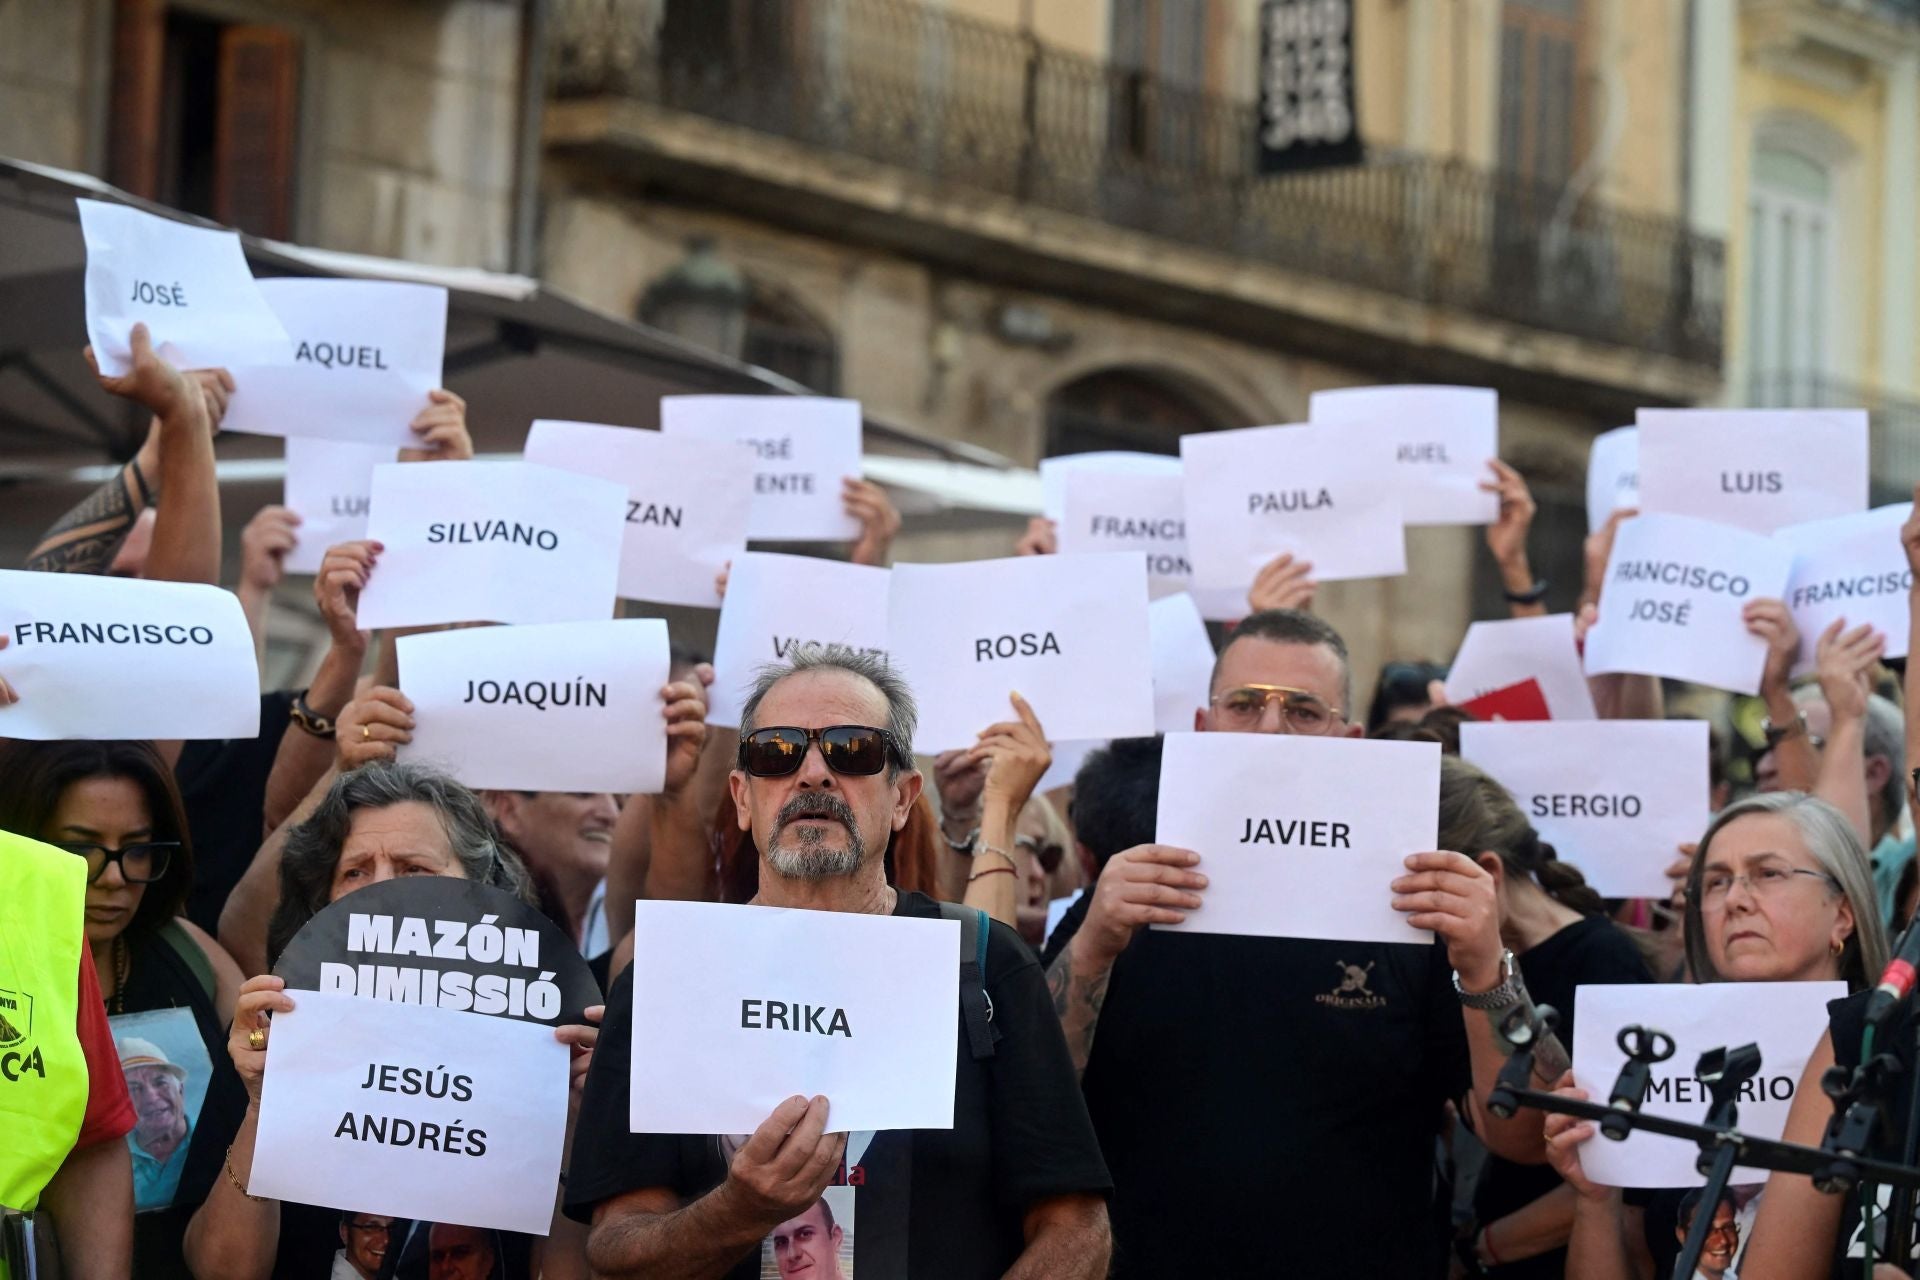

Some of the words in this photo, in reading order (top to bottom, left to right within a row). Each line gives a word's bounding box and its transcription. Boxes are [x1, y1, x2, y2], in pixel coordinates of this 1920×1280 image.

[131, 279, 188, 307] JOSÉ
[1721, 471, 1783, 494] LUIS
[1249, 488, 1334, 513] PAULA
[427, 520, 559, 551] SILVANO
[1630, 599, 1692, 626] JOSÉ
[15, 621, 214, 647] FRANCISCO
[975, 631, 1061, 662] ROSA
[463, 676, 607, 712] JOAQUÍN
[1532, 794, 1641, 819] SERGIO
[1239, 817, 1351, 849] JAVIER
[347, 913, 540, 968] MAZÓN
[319, 962, 562, 1020] DIMISSIÓ
[741, 999, 853, 1038] ERIKA
[361, 1063, 473, 1102] JESÚS
[334, 1111, 487, 1157] ANDRÉS
[830, 1159, 866, 1185] ia
